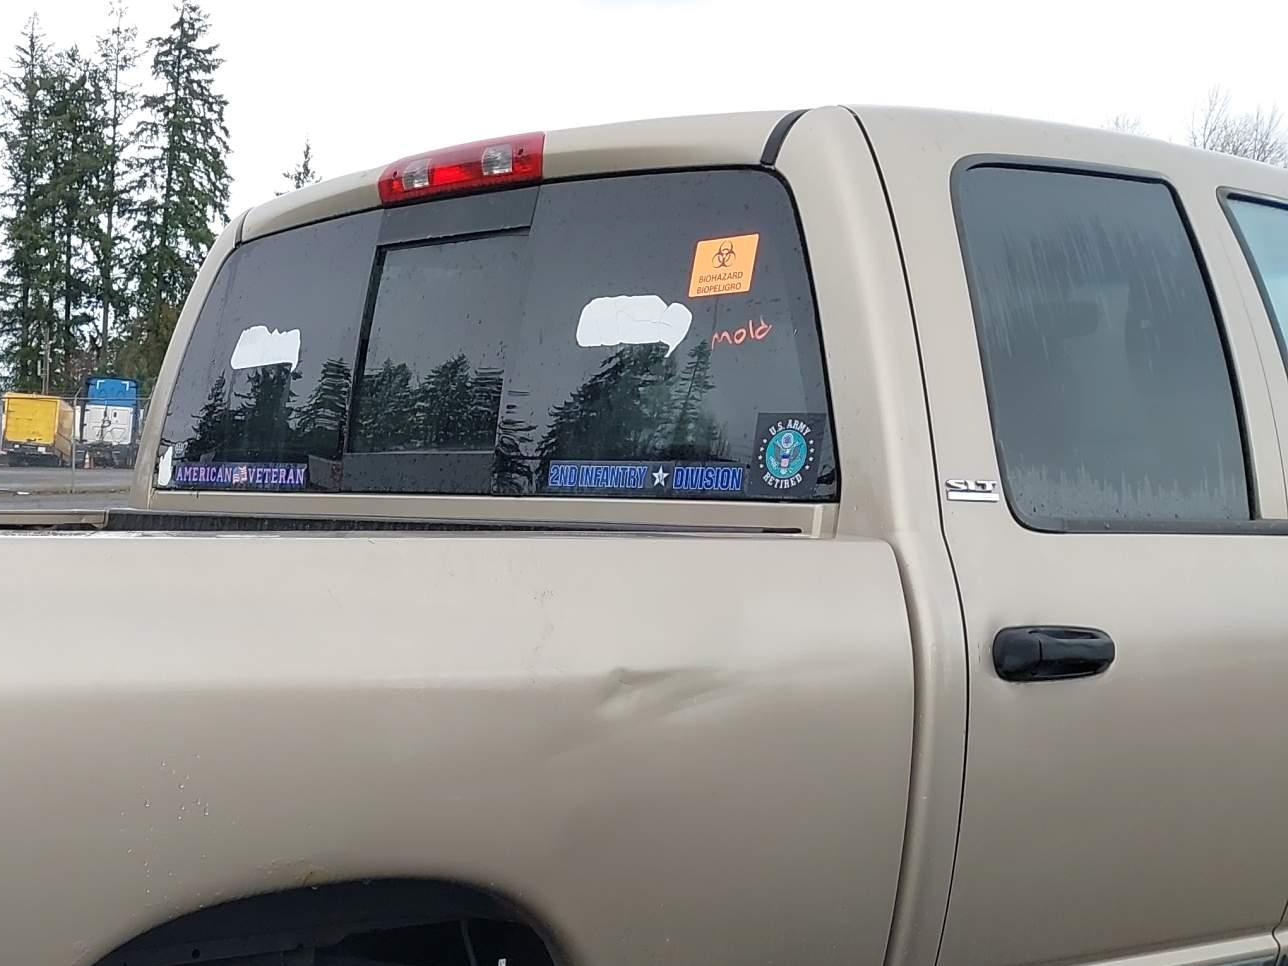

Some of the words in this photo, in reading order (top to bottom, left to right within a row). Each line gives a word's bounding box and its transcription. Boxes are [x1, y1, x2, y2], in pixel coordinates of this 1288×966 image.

[698, 271, 744, 284] BIOHAZARD
[696, 282, 742, 294] BIOPELIGRO
[786, 419, 812, 436] ARMY
[175, 465, 233, 483] AMERICAN
[247, 466, 306, 486] VETERAN
[548, 464, 578, 487] 2ND
[578, 464, 648, 489] INFANTRY
[672, 466, 743, 490] DIVISION
[762, 471, 803, 489] RETIRED
